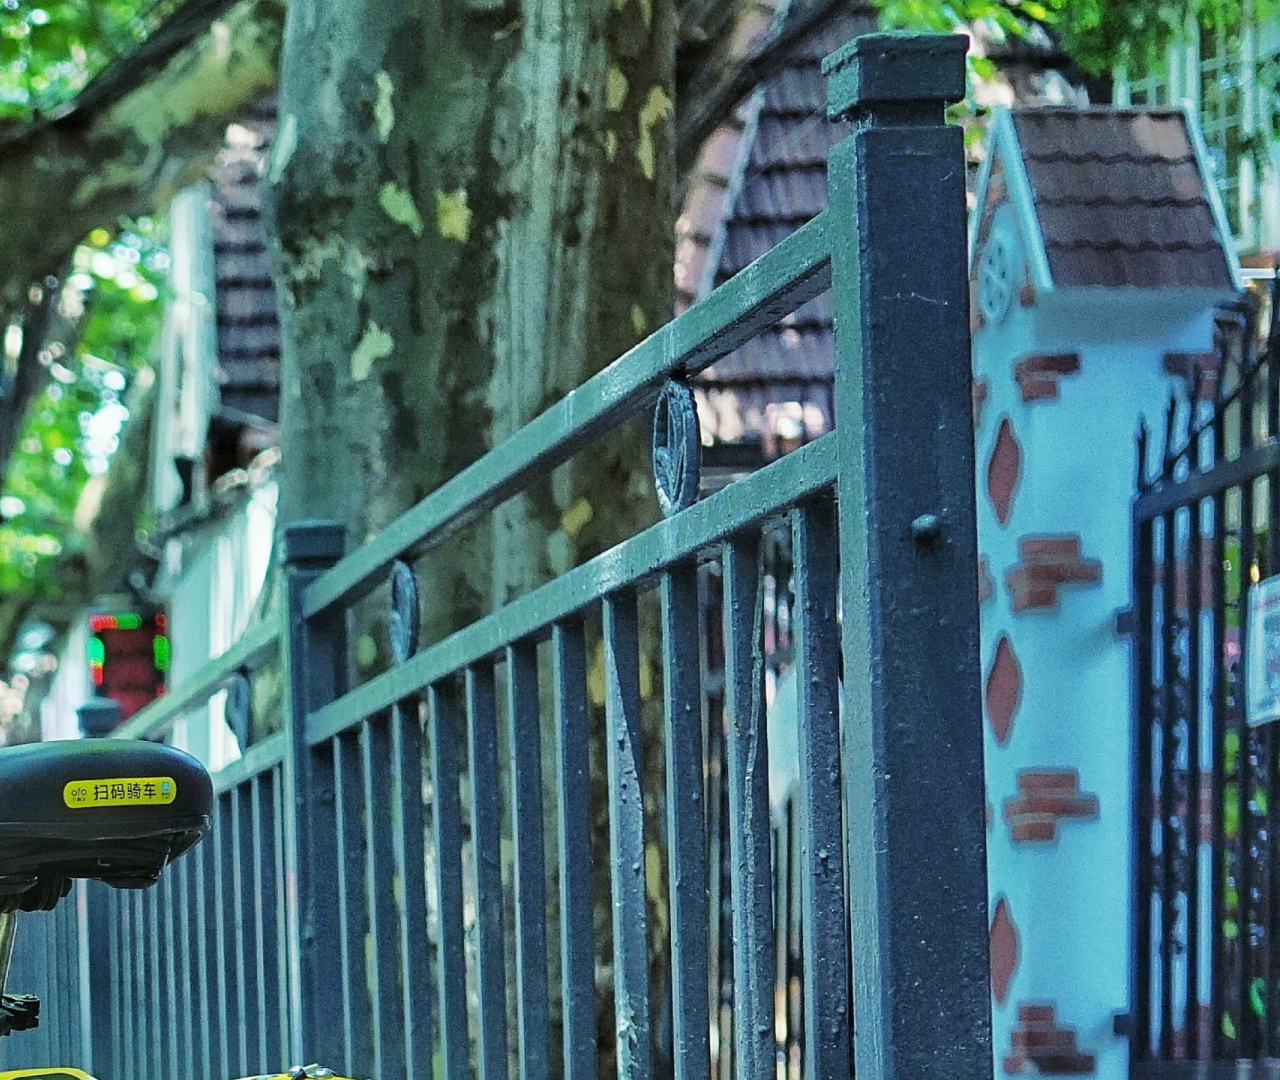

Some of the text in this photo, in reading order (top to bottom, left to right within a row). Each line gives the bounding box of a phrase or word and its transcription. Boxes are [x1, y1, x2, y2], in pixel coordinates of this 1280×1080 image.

[70, 786, 87, 796] ofo
[93, 782, 157, 801] 扫码骑车
